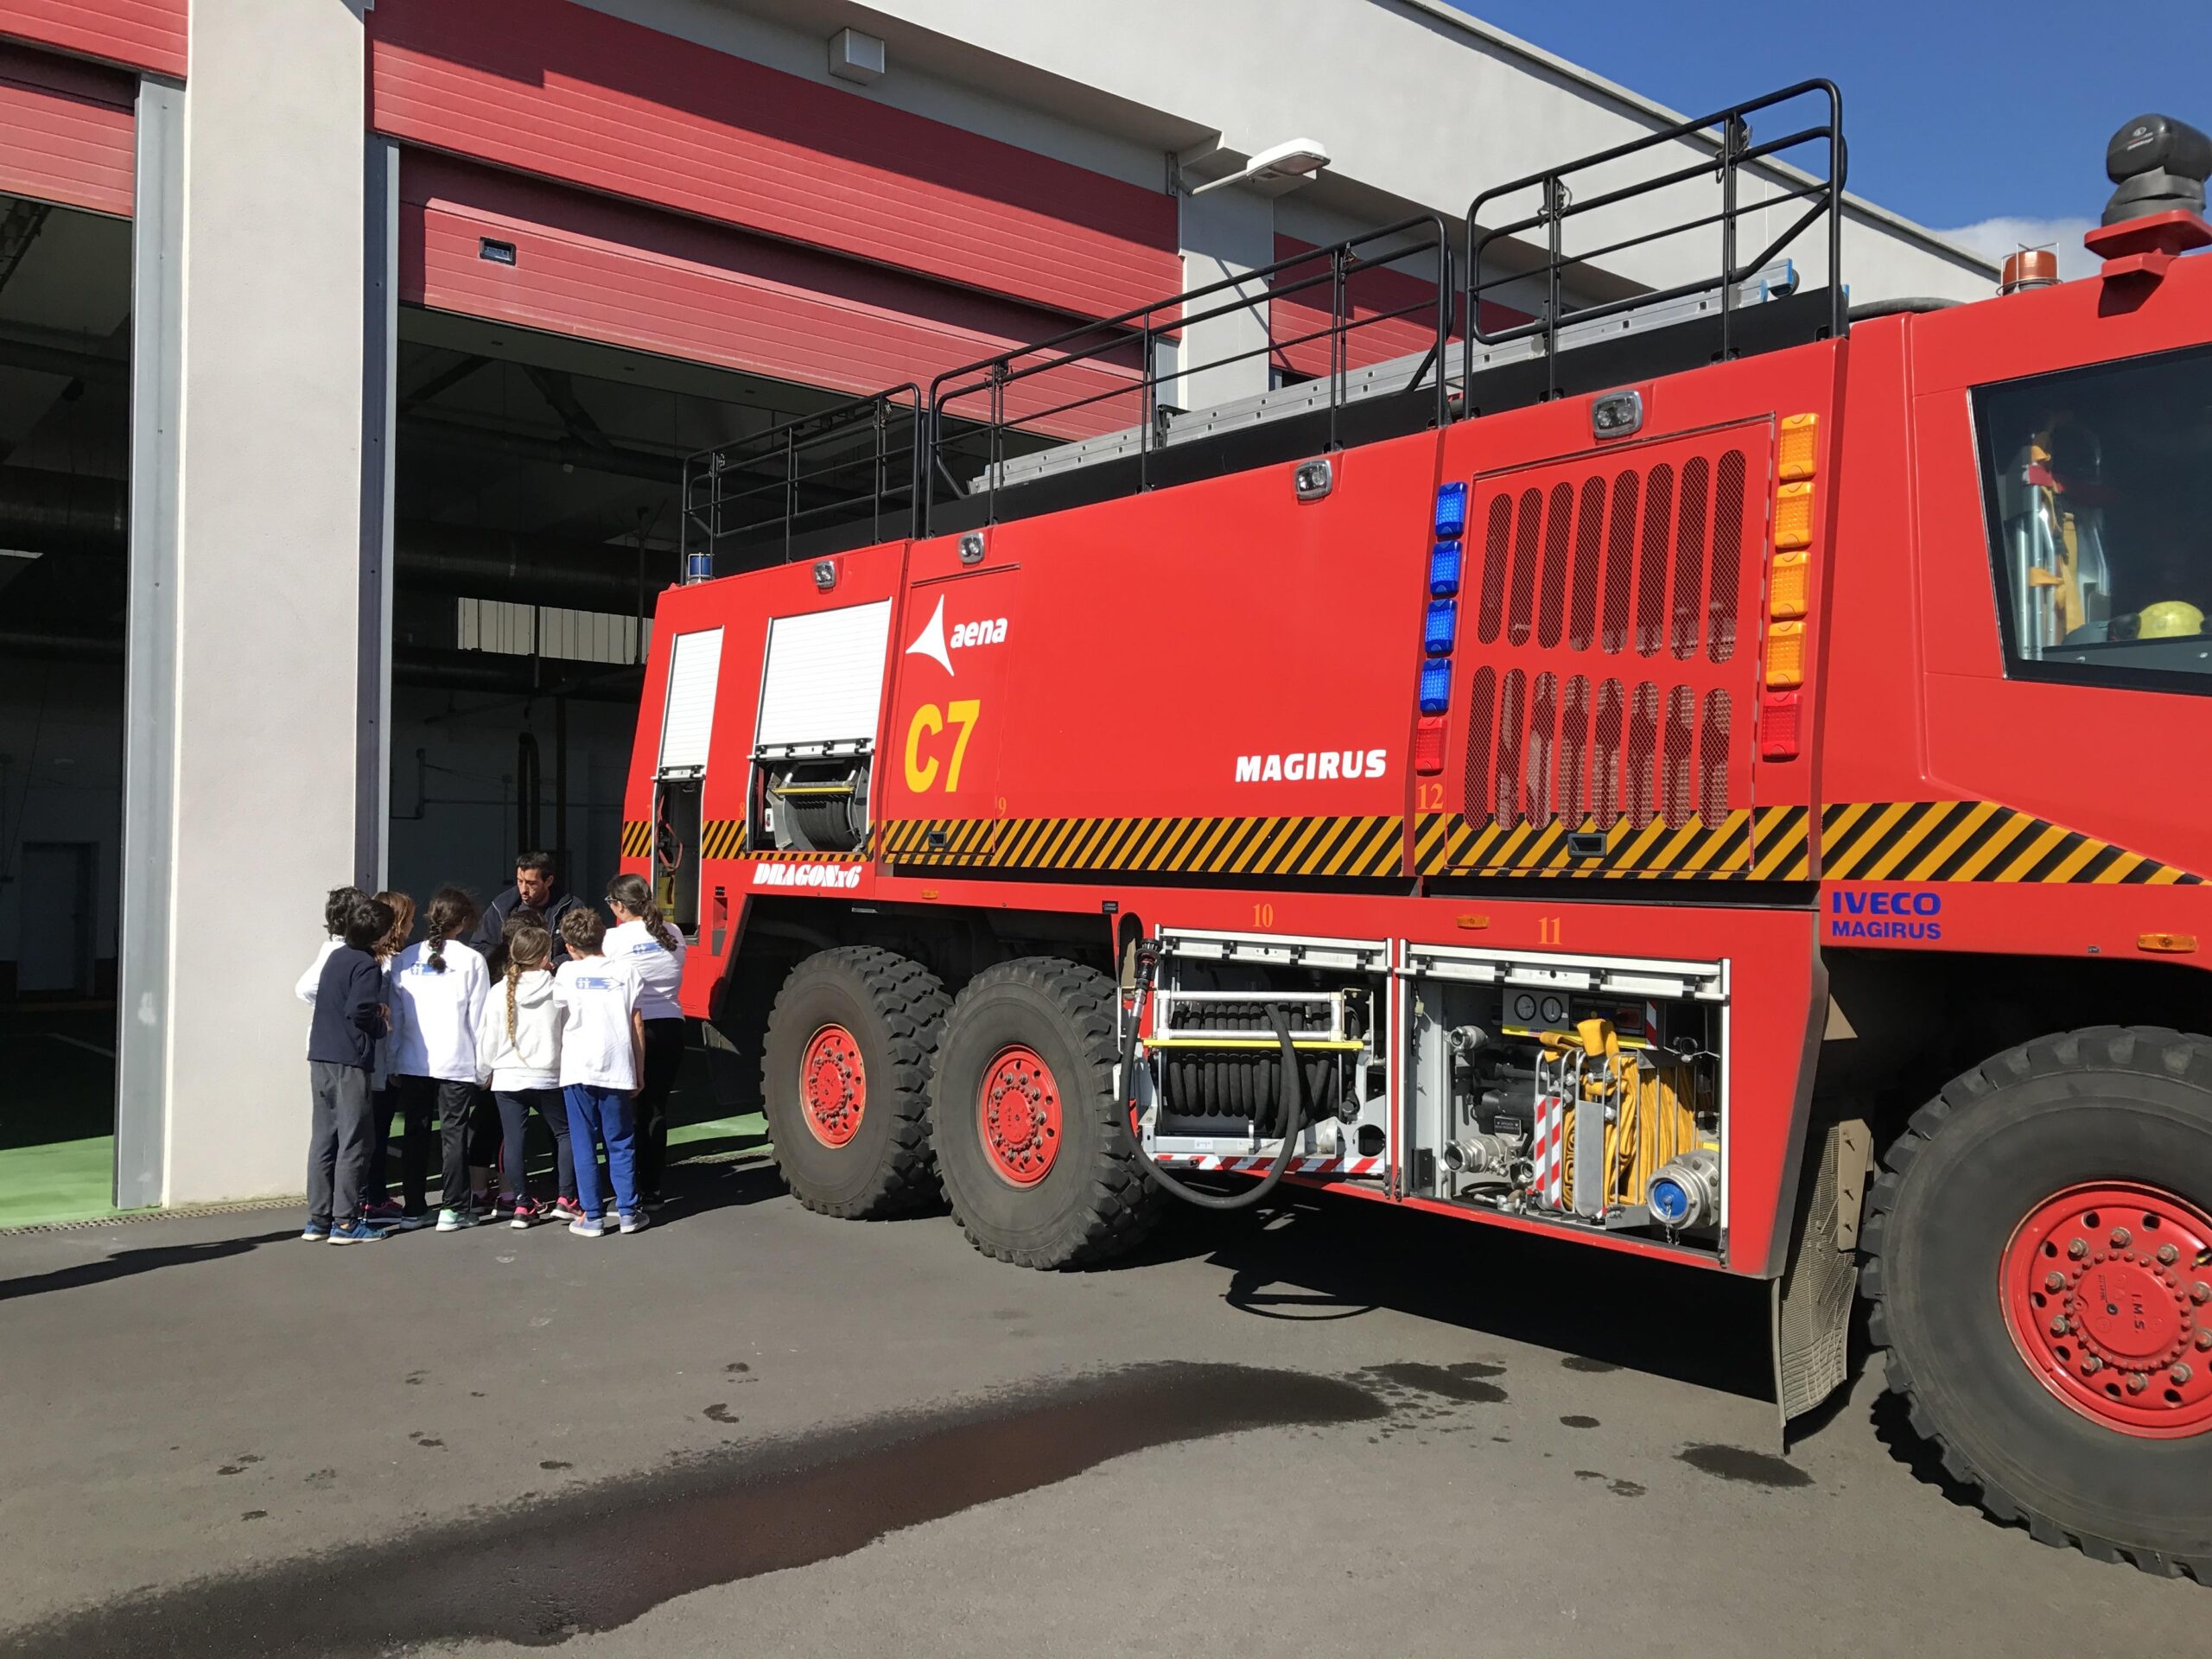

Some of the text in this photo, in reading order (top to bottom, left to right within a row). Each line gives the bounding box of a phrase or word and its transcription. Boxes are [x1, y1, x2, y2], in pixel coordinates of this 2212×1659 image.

[950, 617, 1008, 649] aena
[905, 699, 981, 793] C7
[1235, 749, 1387, 782] MAGIRUS
[998, 797, 1007, 817] 9
[1418, 783, 1444, 810] 12
[739, 801, 745, 819] 8
[1252, 904, 1274, 927] 10
[1832, 891, 1942, 916] IVECO
[1538, 917, 1561, 944] 11
[1832, 920, 1942, 940] MAGIRUS
